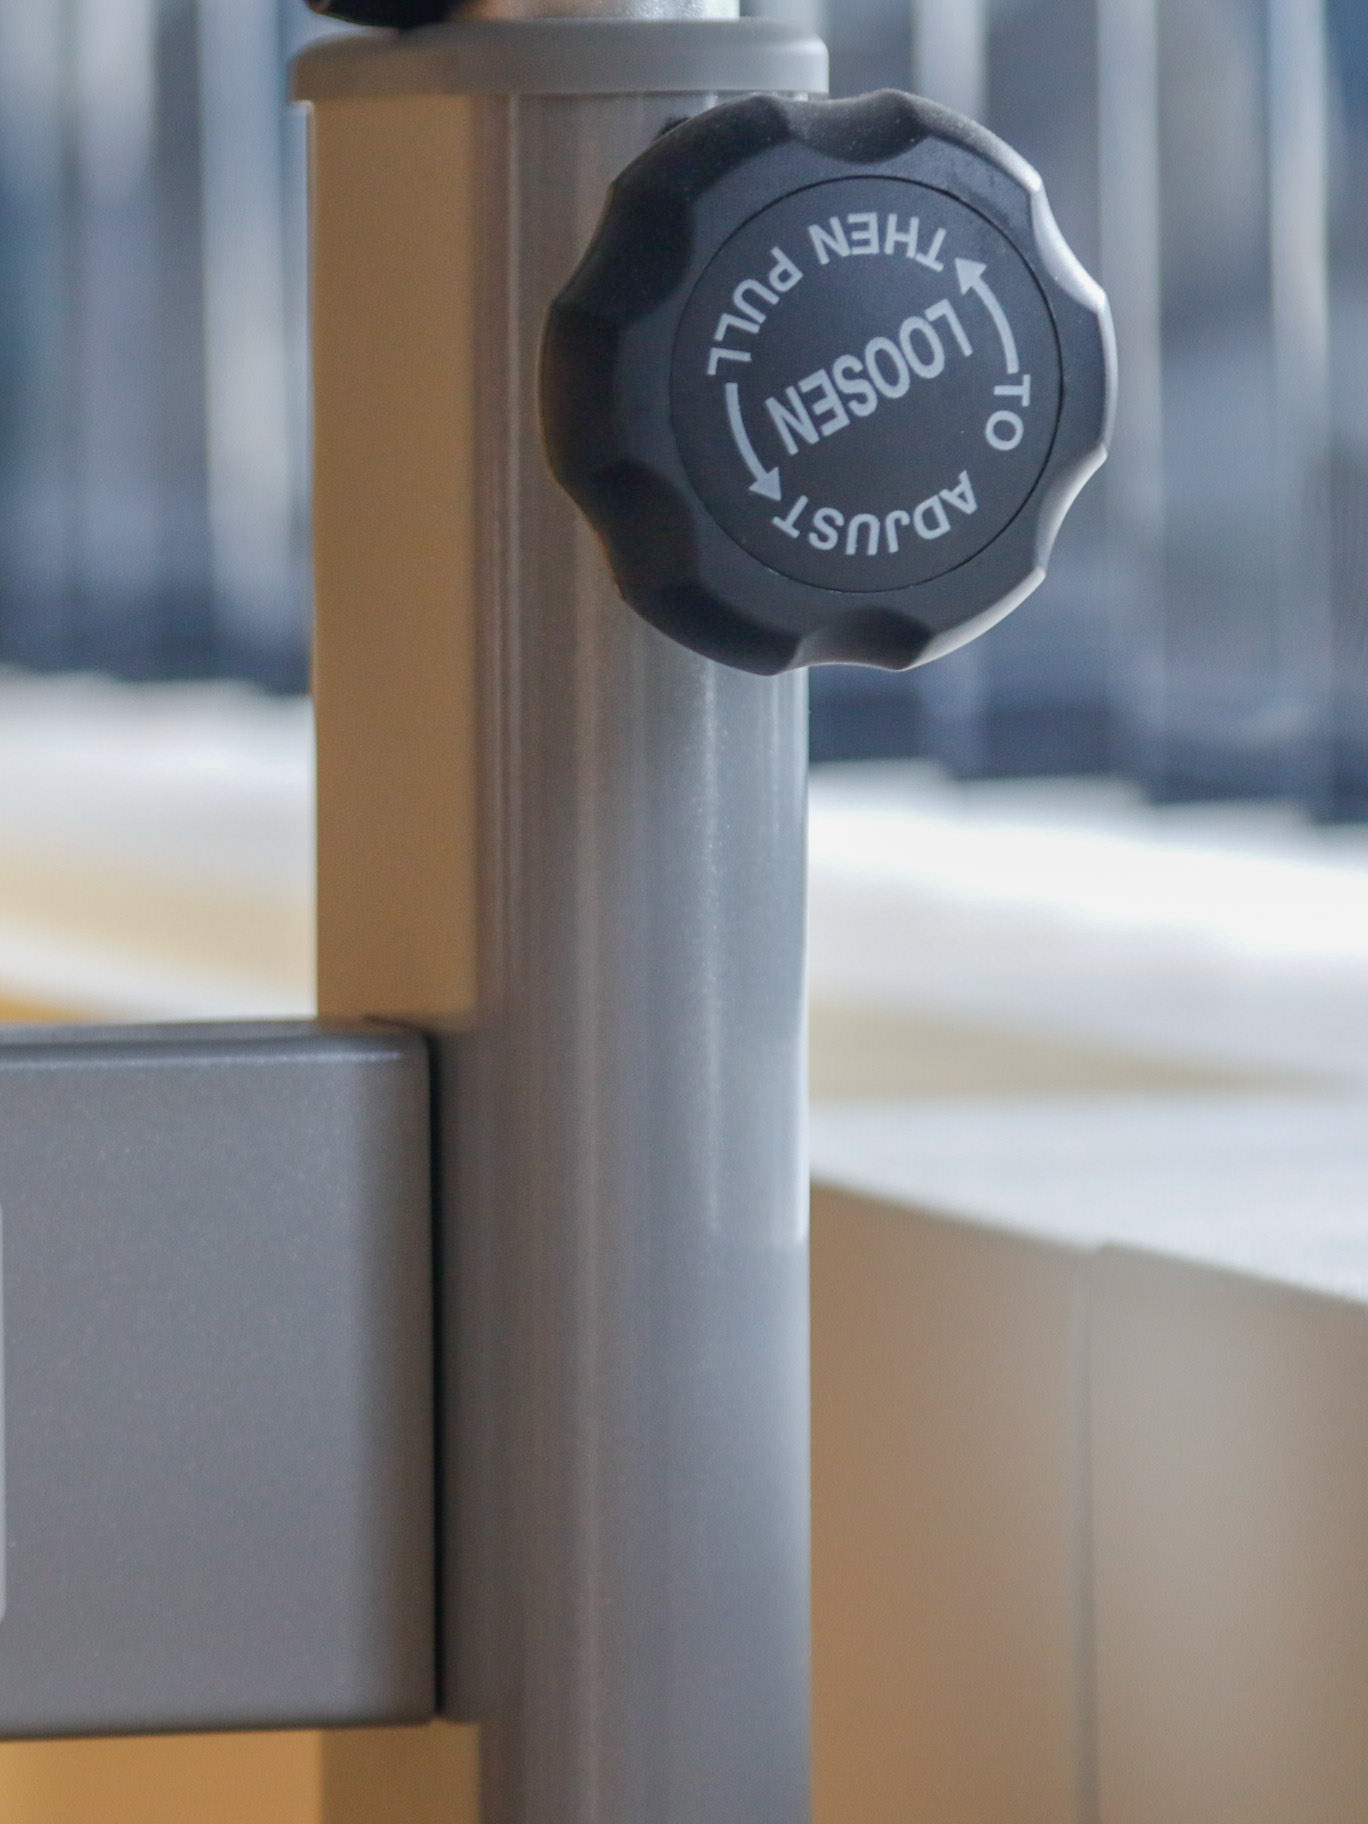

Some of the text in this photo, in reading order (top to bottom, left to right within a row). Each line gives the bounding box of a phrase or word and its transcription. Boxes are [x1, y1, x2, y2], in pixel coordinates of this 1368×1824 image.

[707, 212, 946, 375] THEN PULL
[766, 299, 972, 455] LOOSEN
[772, 374, 1030, 555] TO ADJUST
